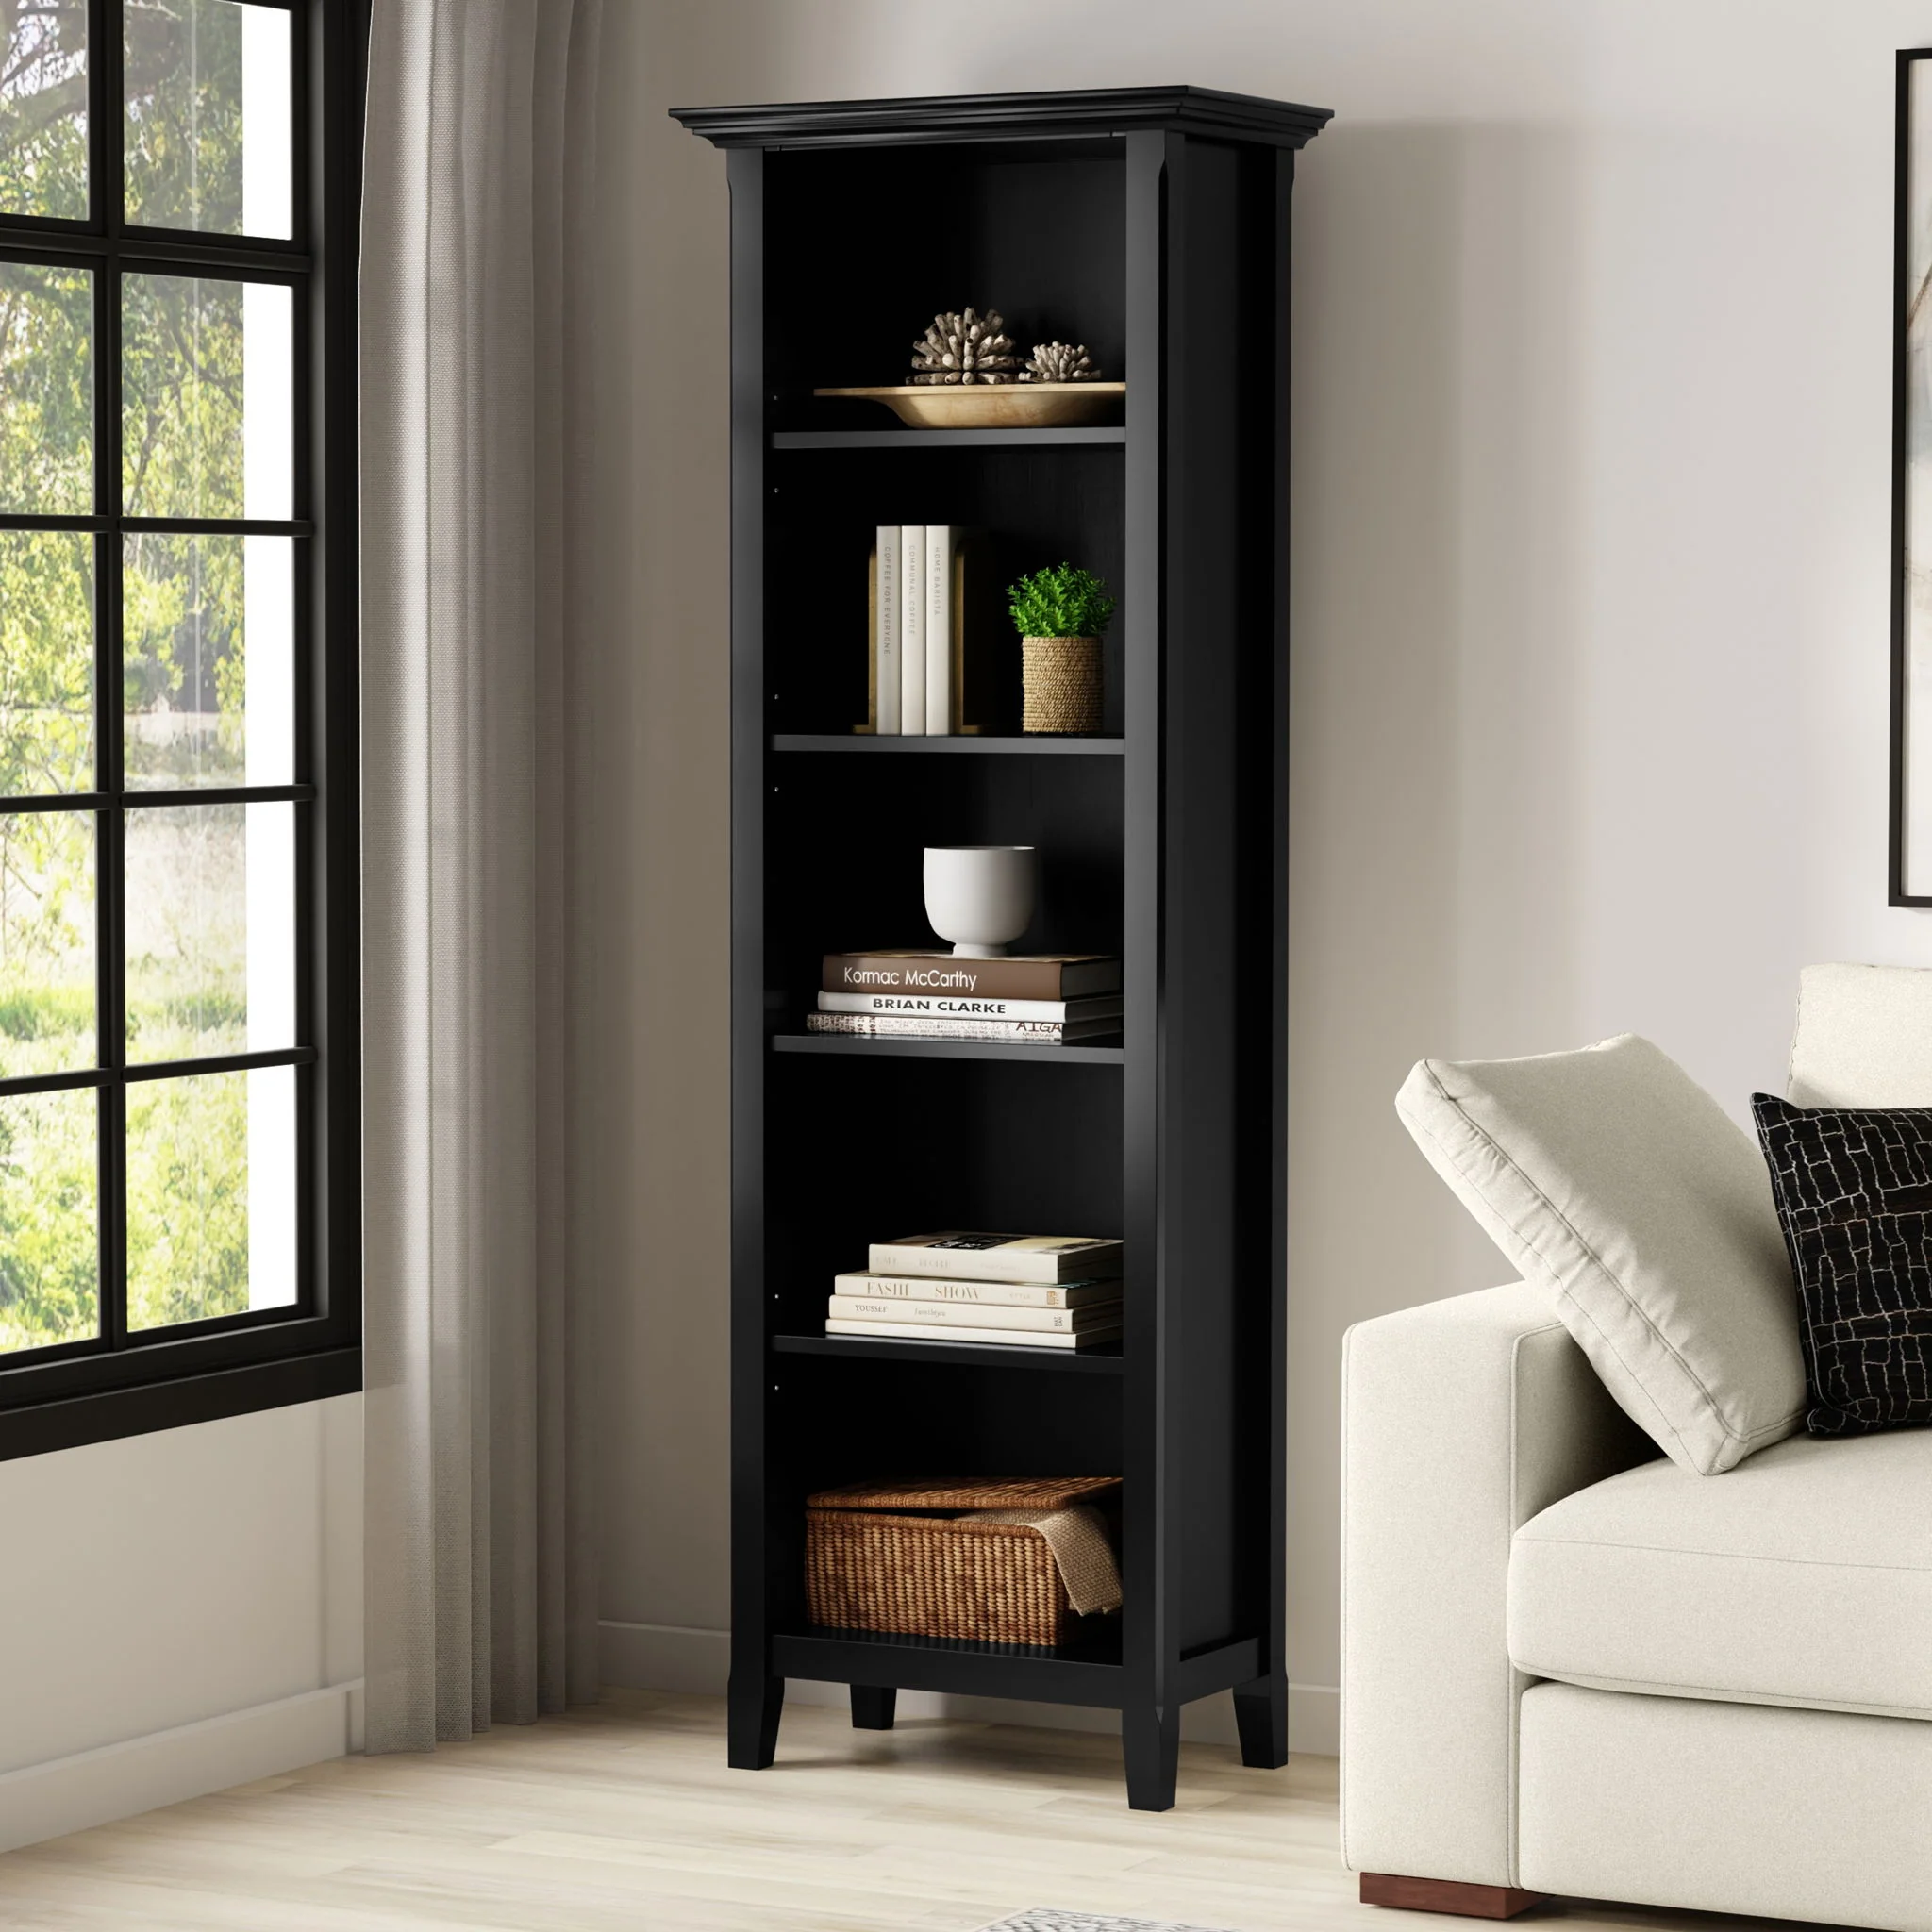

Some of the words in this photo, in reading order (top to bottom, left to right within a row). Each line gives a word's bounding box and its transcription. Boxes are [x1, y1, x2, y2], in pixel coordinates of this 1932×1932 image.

[843, 966, 900, 986] Kormac
[905, 969, 977, 992] McCarthy
[873, 998, 930, 1010] BRIAN
[937, 1001, 1006, 1014] CLARKE
[1016, 1022, 1062, 1033] AIGA
[935, 1286, 979, 1300] SHOW
[855, 1304, 888, 1313] YOUSSEF
